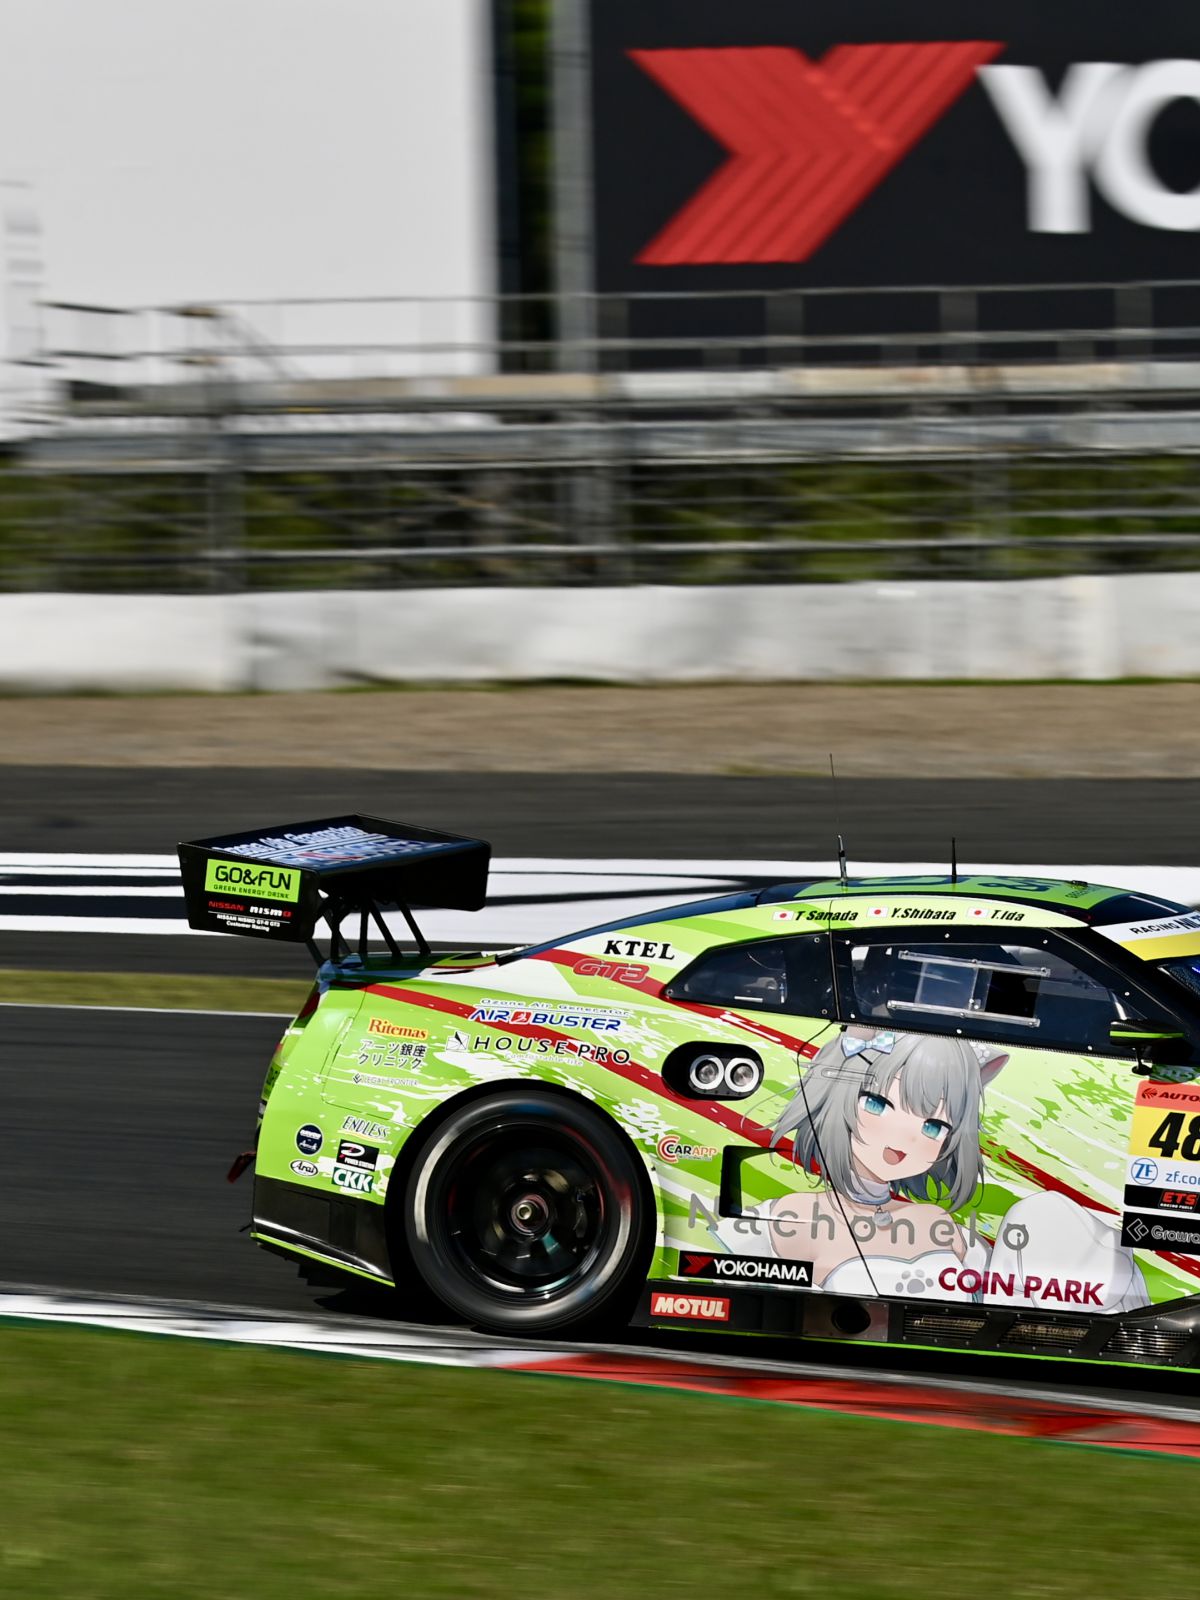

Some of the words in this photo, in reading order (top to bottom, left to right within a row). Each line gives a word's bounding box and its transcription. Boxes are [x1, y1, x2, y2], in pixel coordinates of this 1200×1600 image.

[215, 865, 291, 890] GO&FUN
[213, 884, 237, 893] GREEN
[239, 887, 266, 897] ENERGY
[268, 891, 290, 899] DRINK
[208, 901, 244, 911] NISSAN
[891, 908, 957, 920] Y.Shibata
[806, 911, 859, 921] Sanada
[990, 909, 1026, 922] T.Ida
[1129, 922, 1180, 934] RACING
[603, 940, 675, 960] KTEL
[573, 958, 649, 983] GT3
[481, 999, 525, 1007] Ozone
[532, 1001, 553, 1009] Air
[559, 1004, 630, 1016] Generator
[368, 1018, 427, 1039] Ritemas
[470, 1009, 510, 1021] AIR
[532, 1013, 621, 1031] BUSTER
[360, 1040, 427, 1057] アーツ銀座
[474, 1037, 567, 1055] HOUSE
[577, 1044, 630, 1064] PRO
[359, 1053, 422, 1069] クリニック
[343, 1116, 389, 1138] ENDLESS
[297, 1161, 314, 1172] Arai
[333, 1168, 372, 1192] CKK
[1162, 1191, 1197, 1205] ETS
[713, 1258, 809, 1282] YOKOHAMA
[938, 1267, 1015, 1297] COIN
[1024, 1276, 1104, 1307] PARK
[654, 1297, 726, 1318] MOTUL
